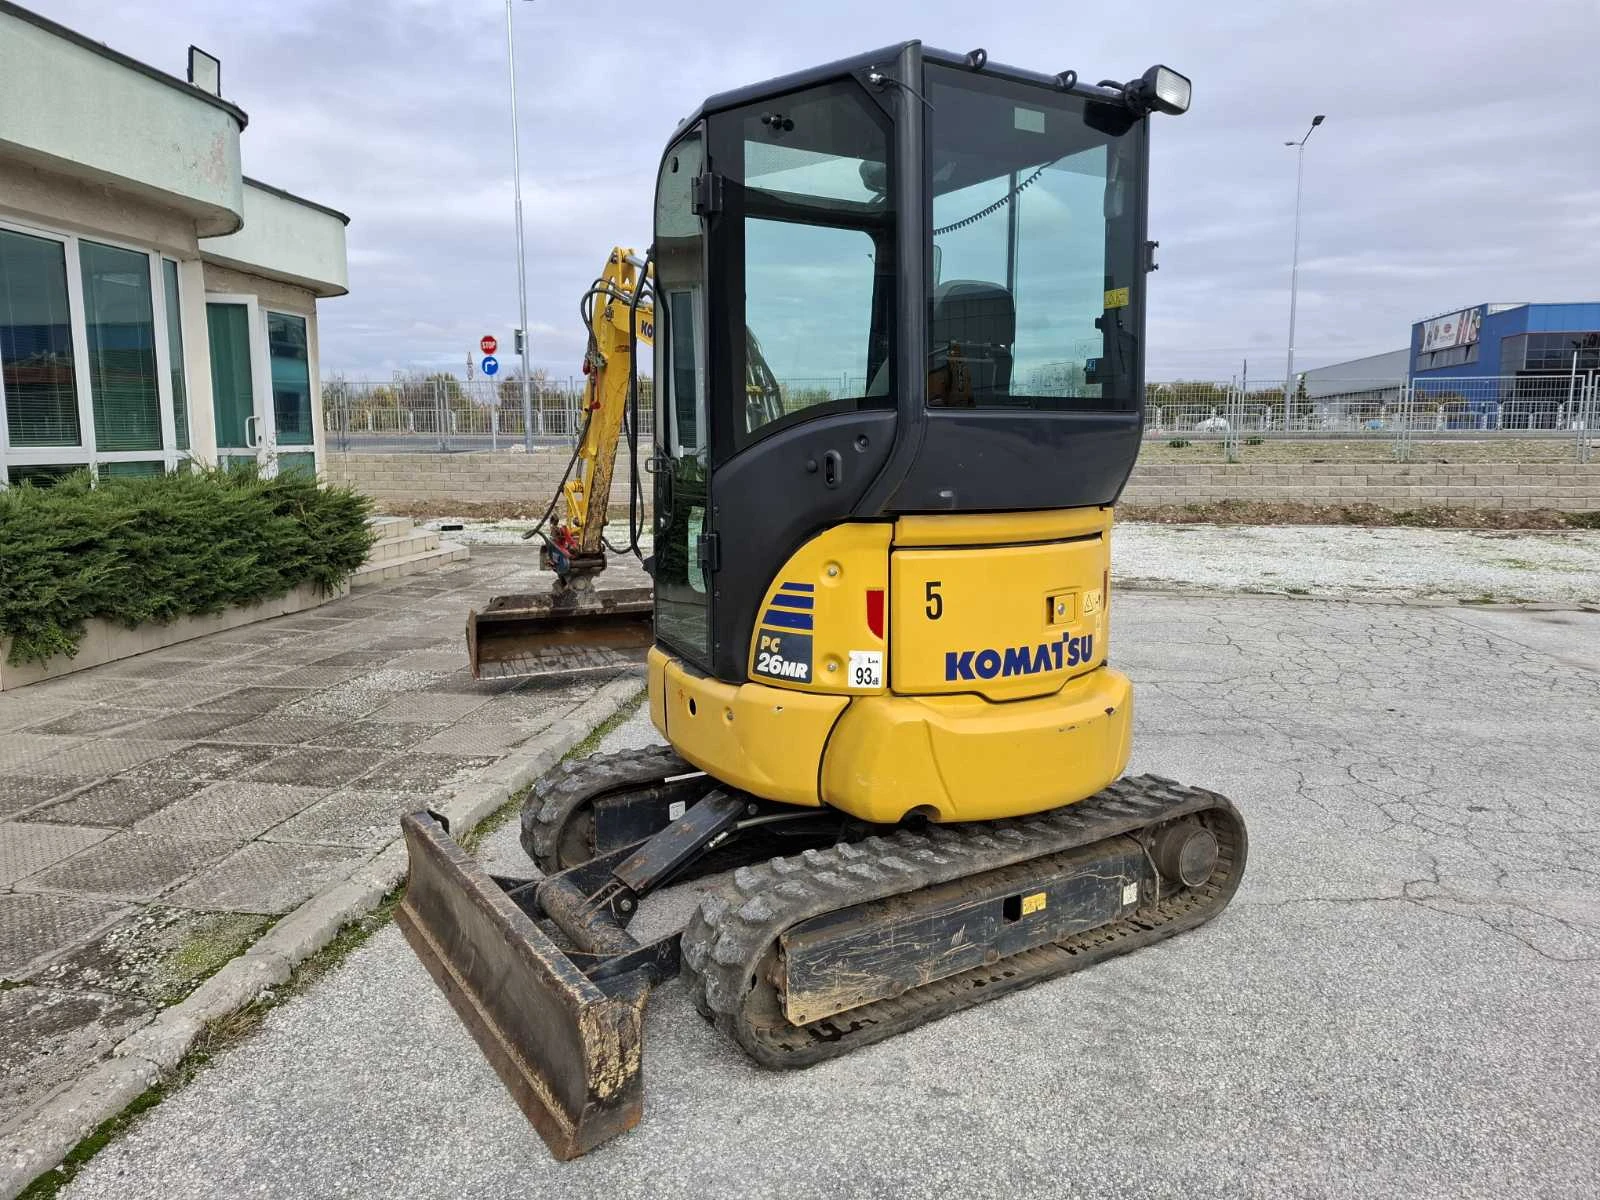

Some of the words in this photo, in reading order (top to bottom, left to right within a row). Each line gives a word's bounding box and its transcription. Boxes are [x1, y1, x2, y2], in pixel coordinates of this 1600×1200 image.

[481, 341, 496, 350] STOP
[925, 581, 943, 620] 5
[760, 635, 781, 653] PC
[945, 631, 1093, 682] KOMATSU
[757, 652, 808, 679] 26MR
